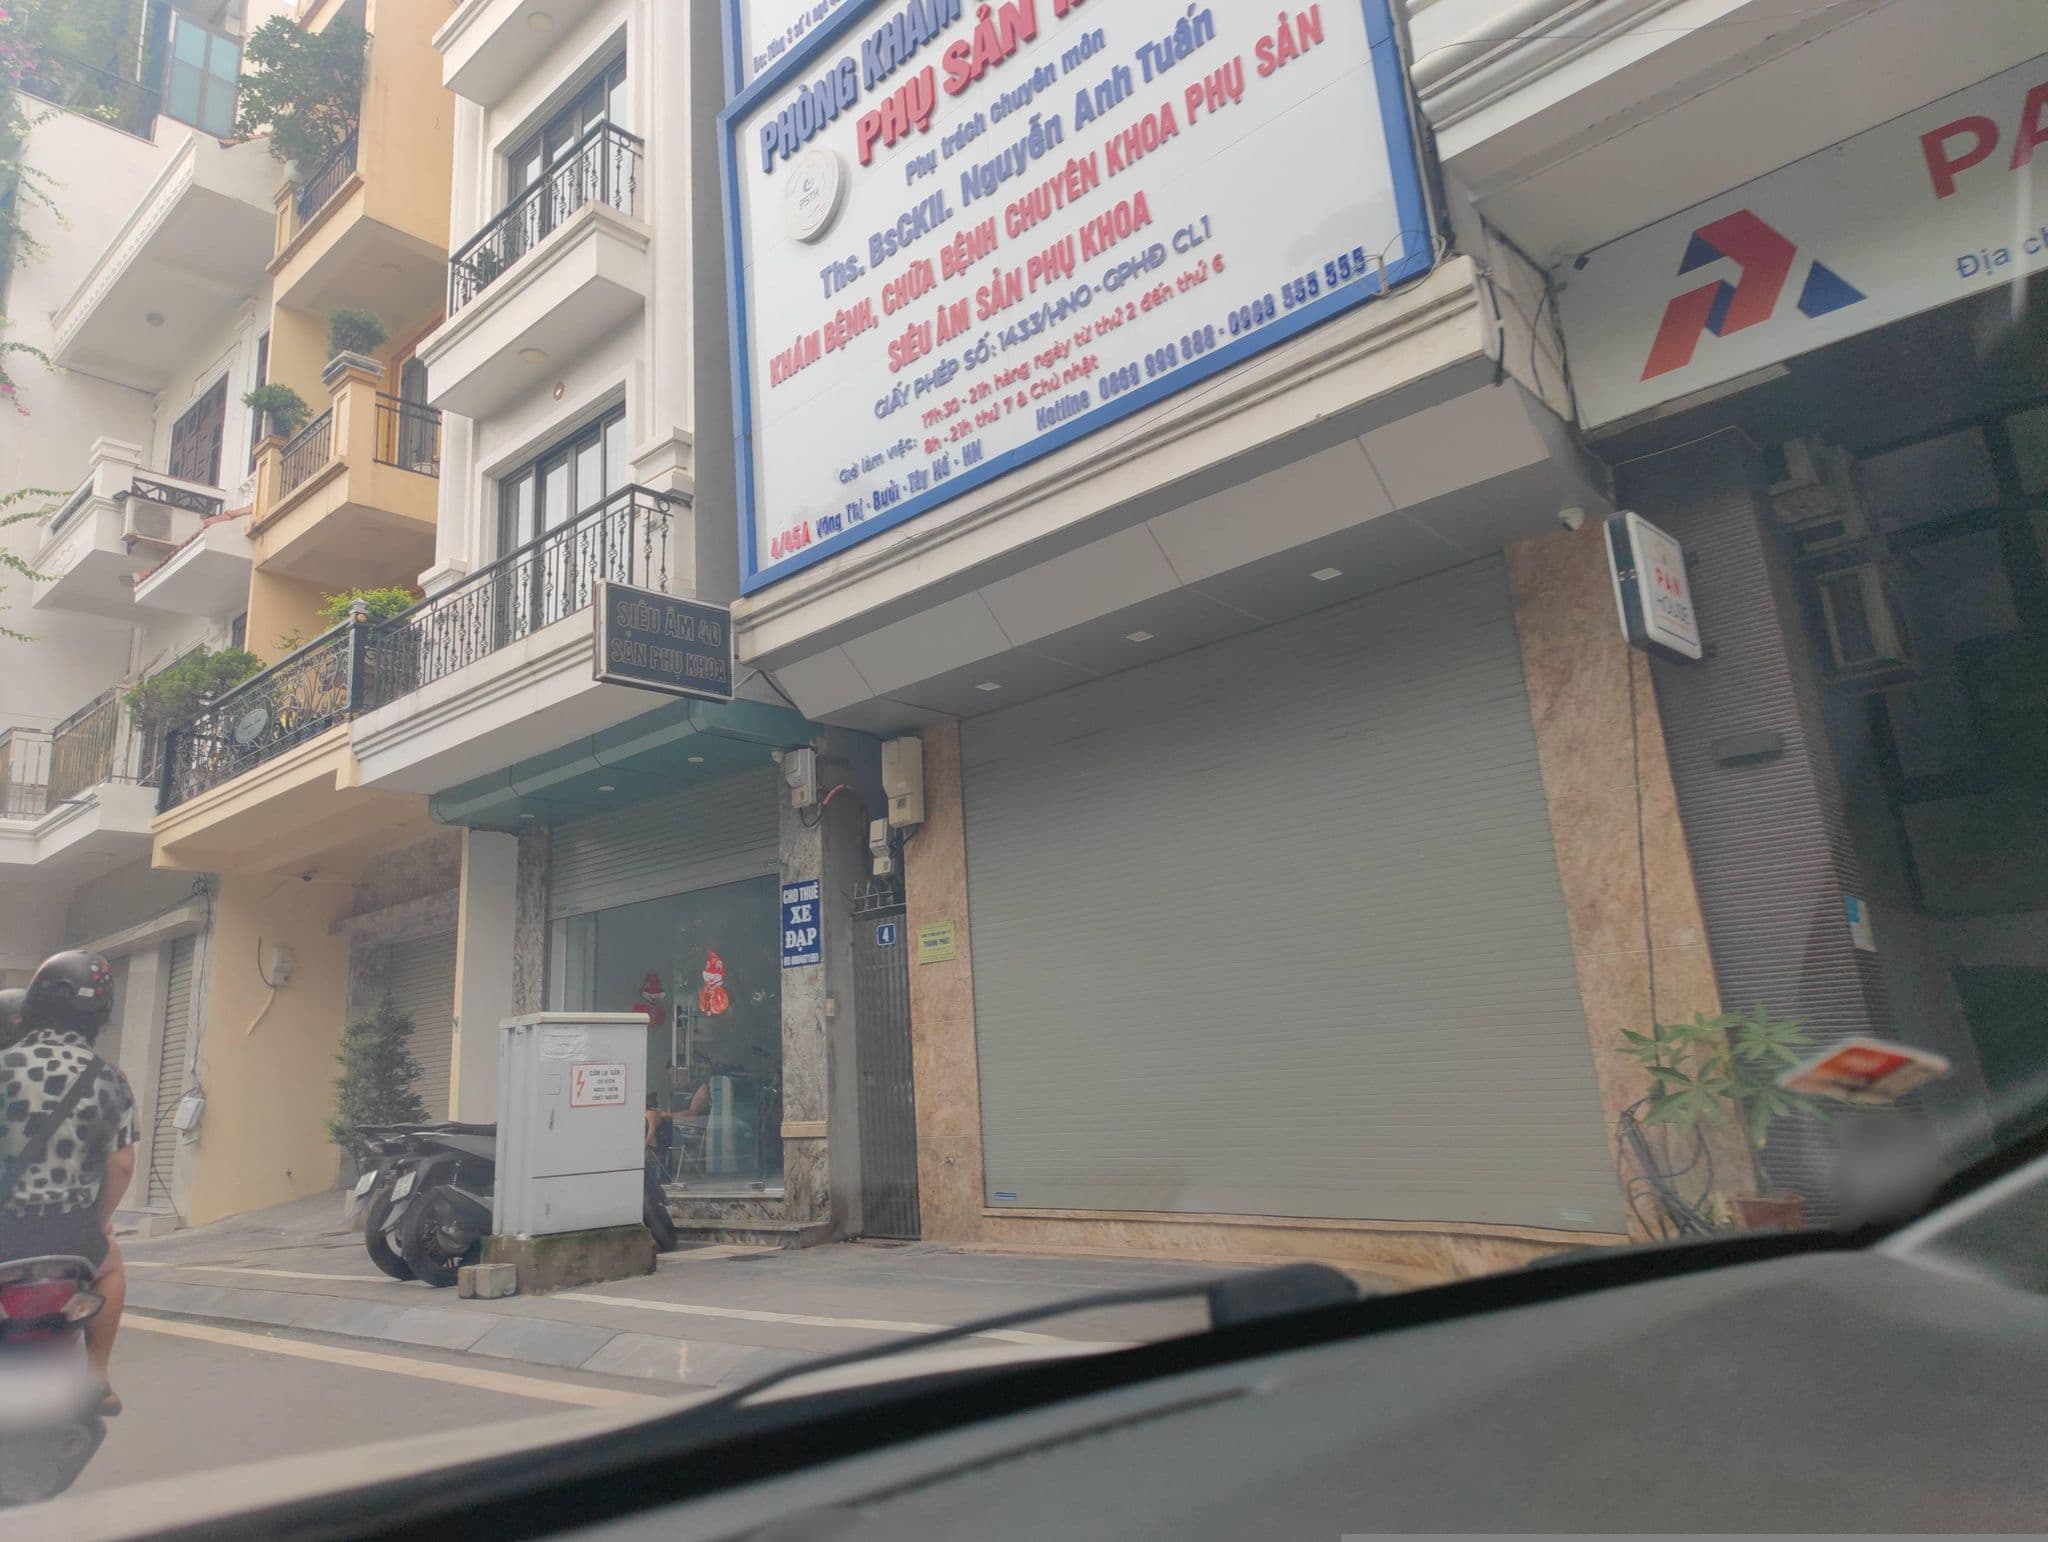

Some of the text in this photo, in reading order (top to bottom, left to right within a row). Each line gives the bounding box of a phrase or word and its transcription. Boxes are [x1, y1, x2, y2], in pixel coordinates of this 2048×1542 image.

[760, 56, 858, 174] PHÒNG
[856, 0, 1038, 167] PHỤ SẢN
[905, 27, 1106, 186] Phụ trách chuyên môn
[769, 329, 823, 388] KHÁM
[882, 258, 937, 316] CHỮA
[940, 215, 998, 284] BỆNH
[1004, 151, 1100, 240] CHUYÊN
[1104, 101, 1179, 179] KHOA
[1184, 55, 1246, 127] PHỤ
[1254, 3, 1325, 78] SẢN
[820, 254, 865, 299] Ths.
[1074, 64, 1134, 131] Anh
[1136, 2, 1216, 84] Tuấn
[888, 190, 1153, 373] SIÊU ÂM SẢN PHỤ KHOA
[1955, 247, 2011, 279] Địa
[993, 362, 1030, 391] hàng
[1033, 338, 1072, 369] ngày
[1094, 306, 1124, 336] thứ
[1126, 301, 1137, 321] 2
[1140, 281, 1174, 312] đến
[1175, 259, 1208, 293] thứ
[1212, 253, 1225, 274] 6
[1035, 389, 1091, 431] Hotline
[1324, 245, 1367, 288] 555
[874, 380, 911, 420] GIẤY
[913, 358, 960, 399] PHÉP
[963, 330, 998, 371] SỐ:
[1003, 395, 1013, 414] 7
[685, 652, 728, 683] KHOA
[783, 888, 799, 904] CHO
[785, 927, 817, 952] ĐẠP
[790, 904, 813, 924] XE
[881, 927, 890, 942] 4
